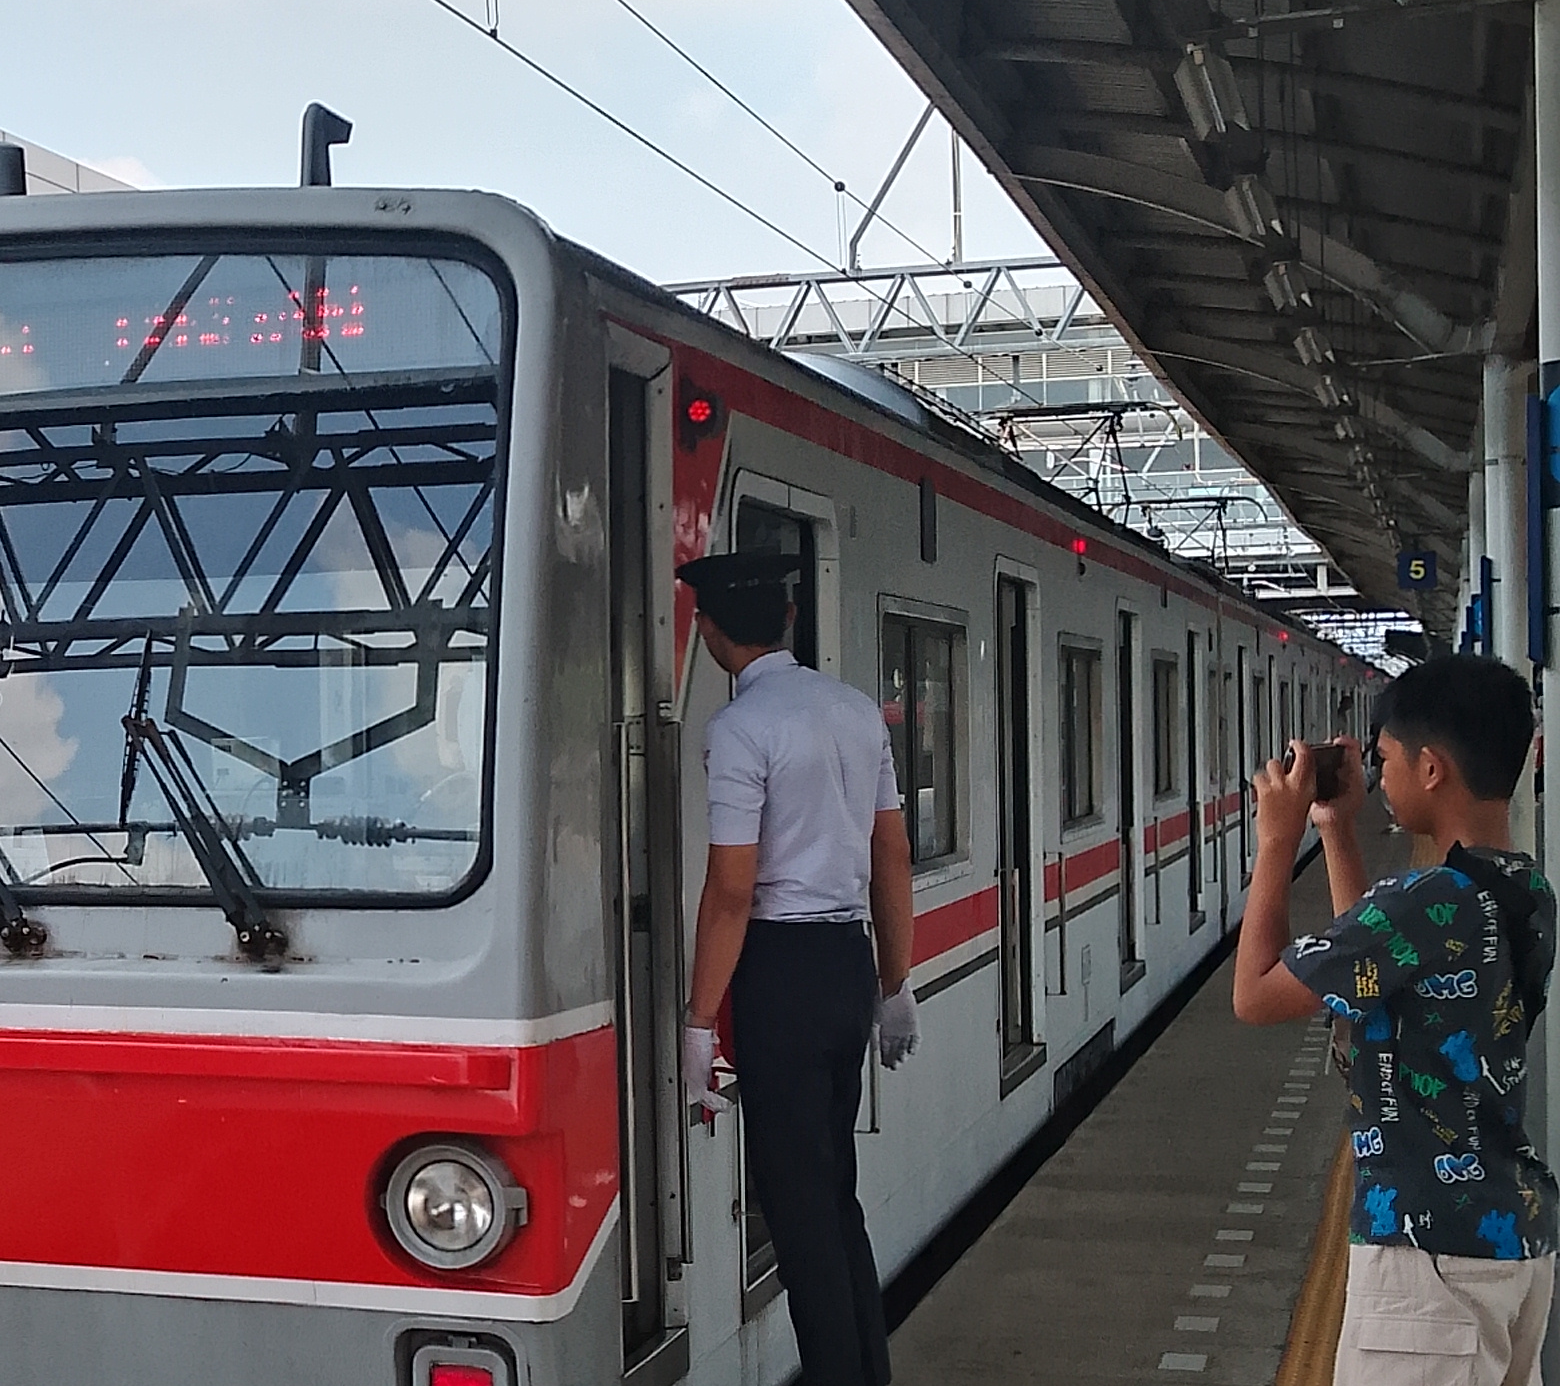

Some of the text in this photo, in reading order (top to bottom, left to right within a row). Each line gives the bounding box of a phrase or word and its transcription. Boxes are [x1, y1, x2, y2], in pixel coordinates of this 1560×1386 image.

[1409, 560, 1425, 579] 5
[1482, 936, 1498, 964] FUN
[1378, 1053, 1394, 1080] END
[1380, 1097, 1400, 1122] FUN
